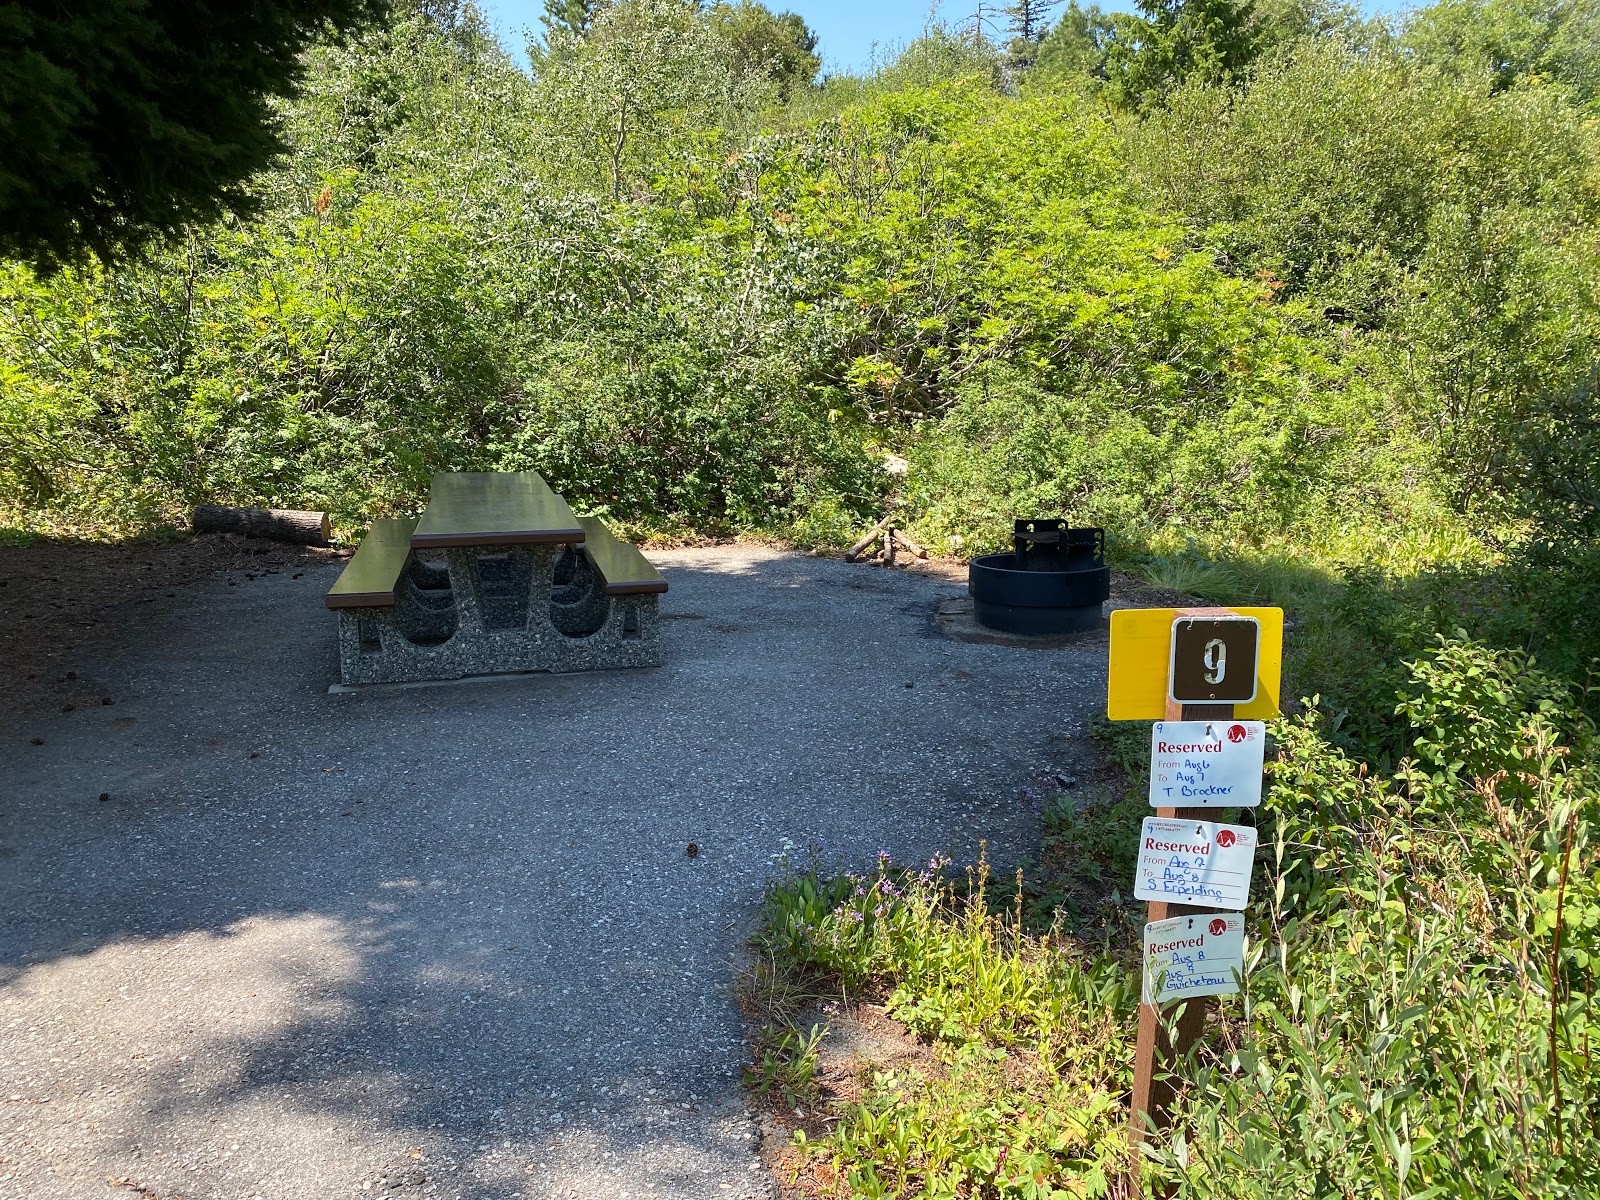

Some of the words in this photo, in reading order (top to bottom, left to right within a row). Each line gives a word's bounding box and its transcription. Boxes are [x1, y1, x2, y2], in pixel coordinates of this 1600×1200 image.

[1204, 638, 1227, 684] 9
[1157, 724, 1163, 733] 9
[1158, 740, 1222, 753] Reserved
[1158, 774, 1168, 782] To
[1176, 772, 1195, 784] Aug
[1197, 772, 1204, 781] 7
[1145, 838, 1211, 855] Reserved
[1143, 855, 1167, 865] From
[1169, 855, 1191, 874] Aug
[1143, 869, 1153, 877] To
[1163, 867, 1186, 885] Aug
[1192, 873, 1199, 882] 8
[1146, 925, 1152, 933] 9
[1149, 934, 1204, 955] Reserved
[1172, 952, 1193, 969] Aug
